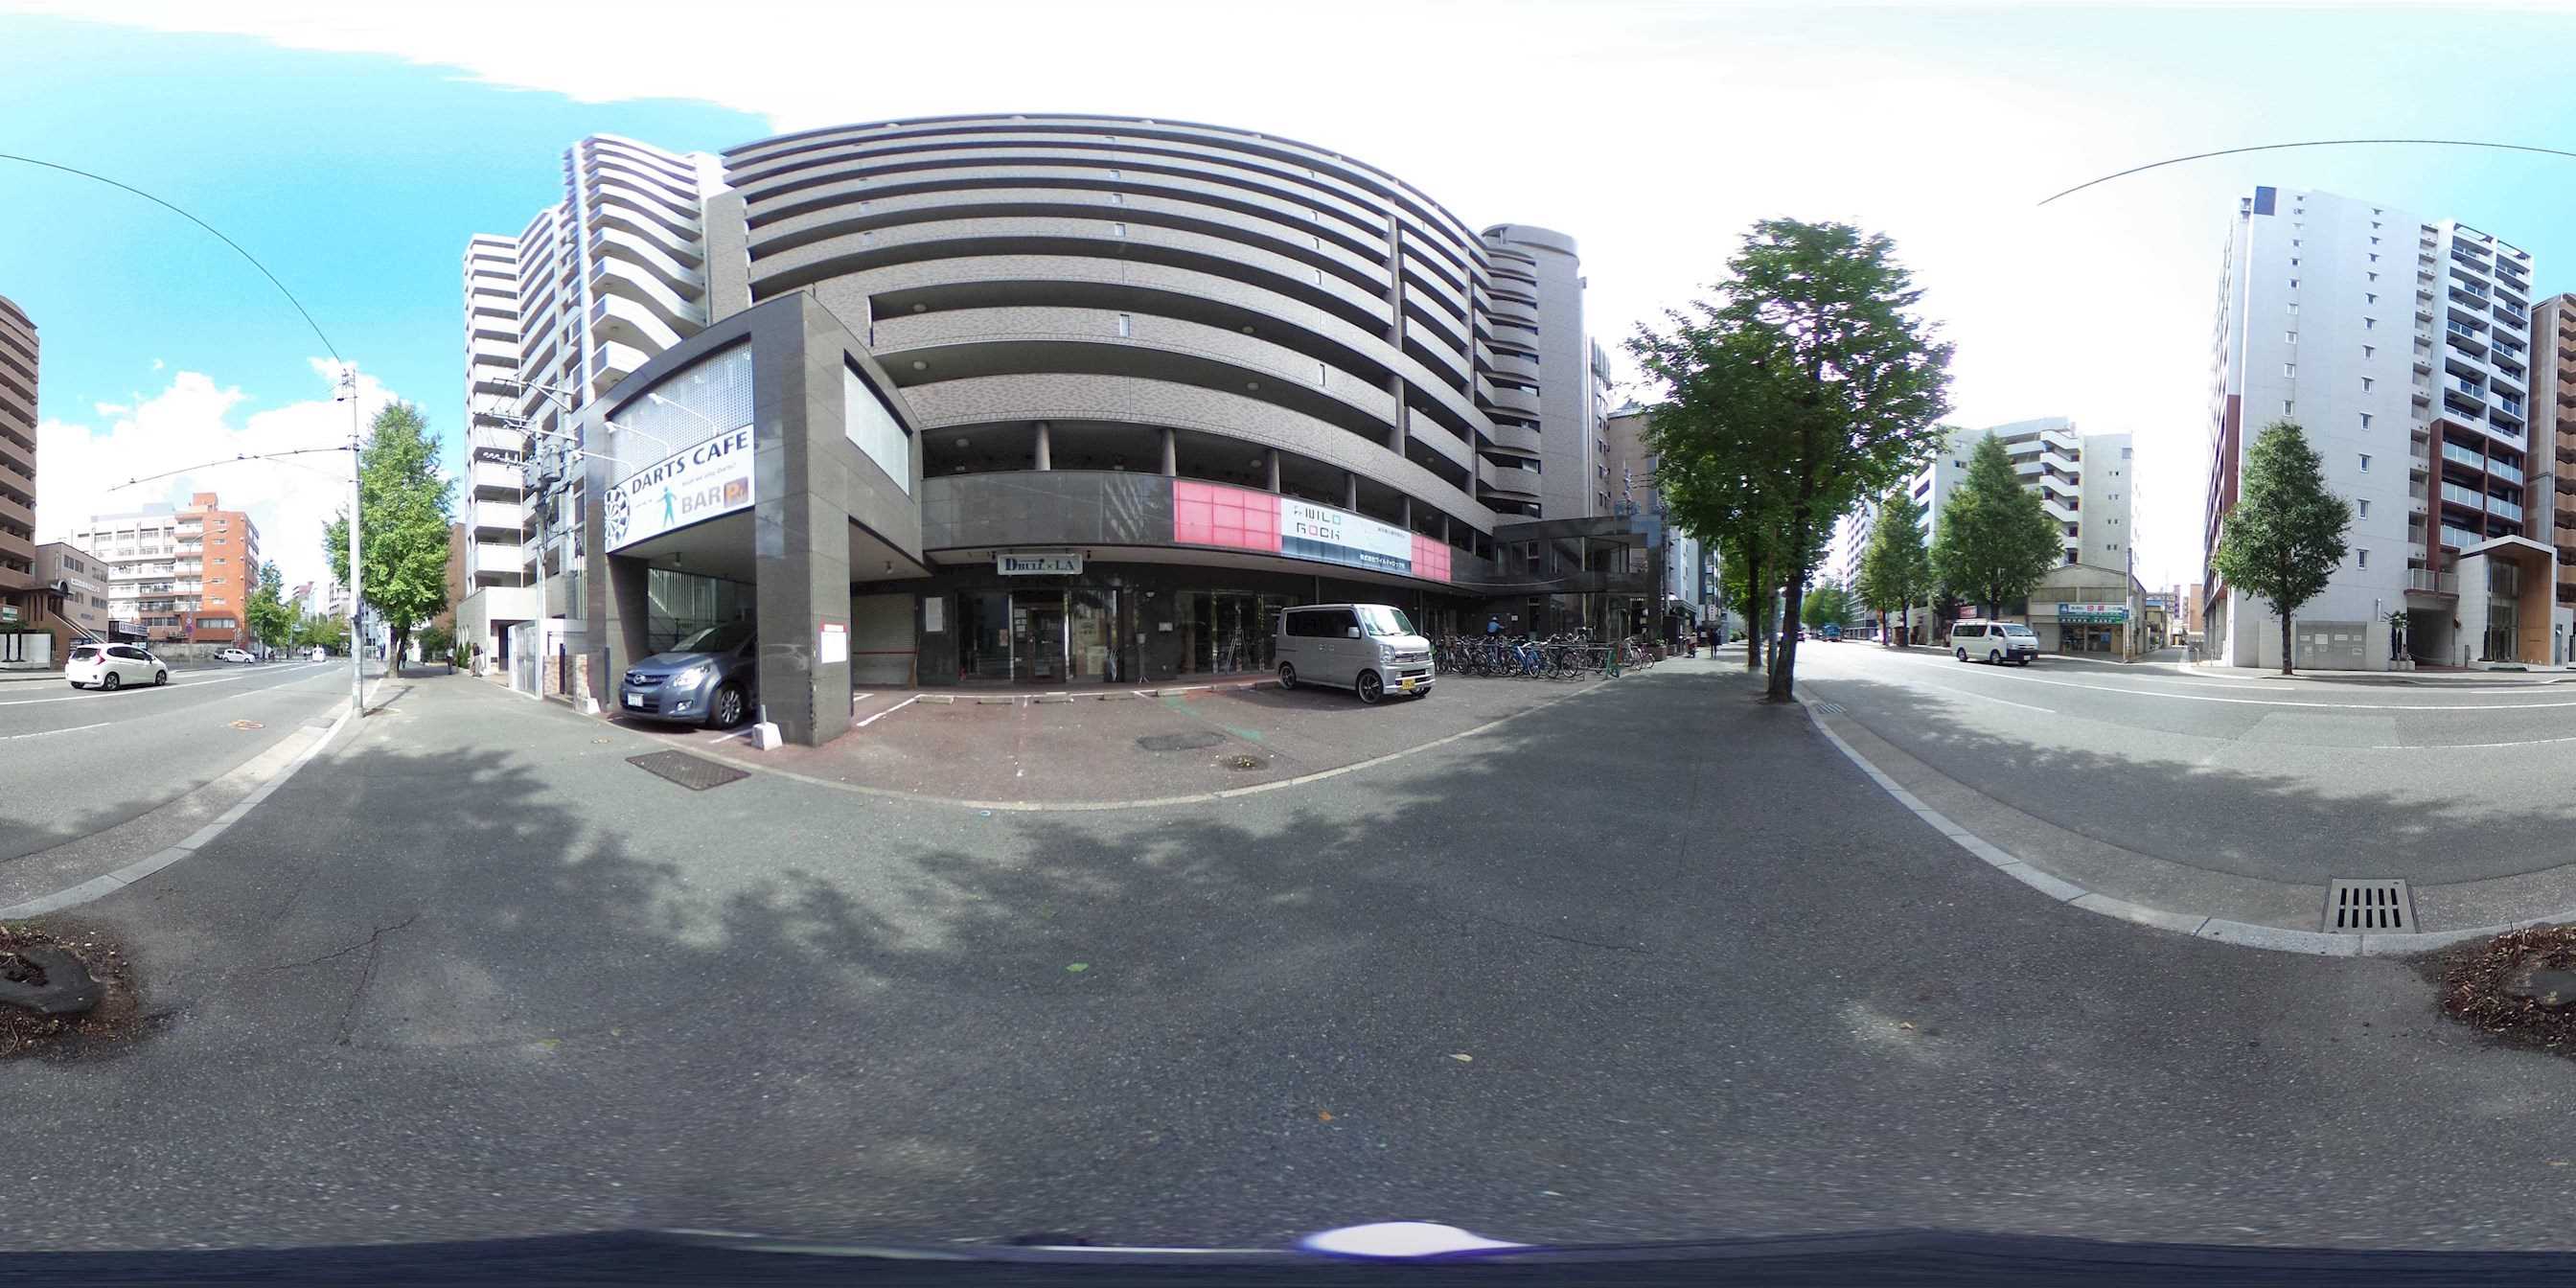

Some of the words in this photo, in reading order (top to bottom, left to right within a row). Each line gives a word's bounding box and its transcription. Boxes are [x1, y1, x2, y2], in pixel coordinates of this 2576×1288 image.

[632, 456, 685, 494] DARTS
[693, 431, 748, 466] CAFE
[681, 486, 722, 515] BAR
